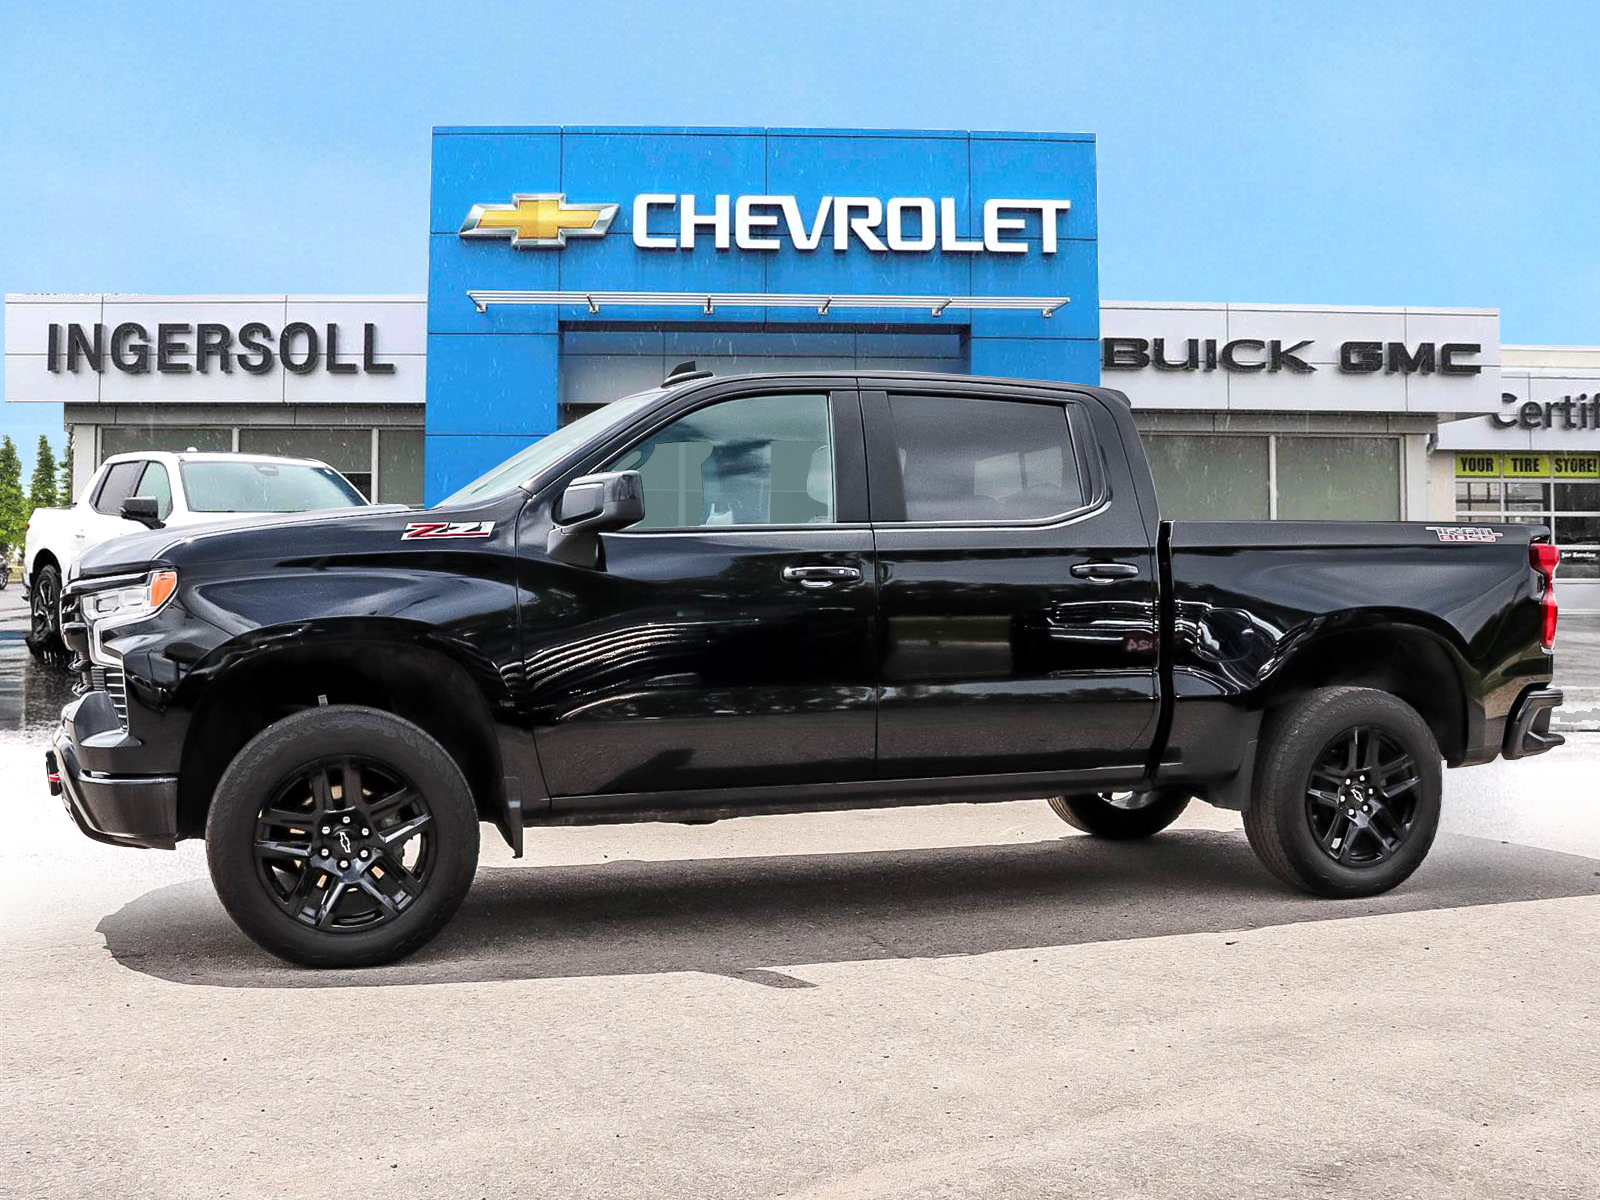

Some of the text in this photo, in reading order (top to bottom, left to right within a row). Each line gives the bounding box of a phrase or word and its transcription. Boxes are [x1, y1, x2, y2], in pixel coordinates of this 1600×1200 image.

[632, 194, 1071, 254] CHEVROLET
[48, 322, 395, 374] INGERSOLL
[1101, 337, 1482, 374] BUICK GMC
[1460, 457, 1597, 473] YOUR TIRE STORE!
[401, 522, 496, 541] Z71
